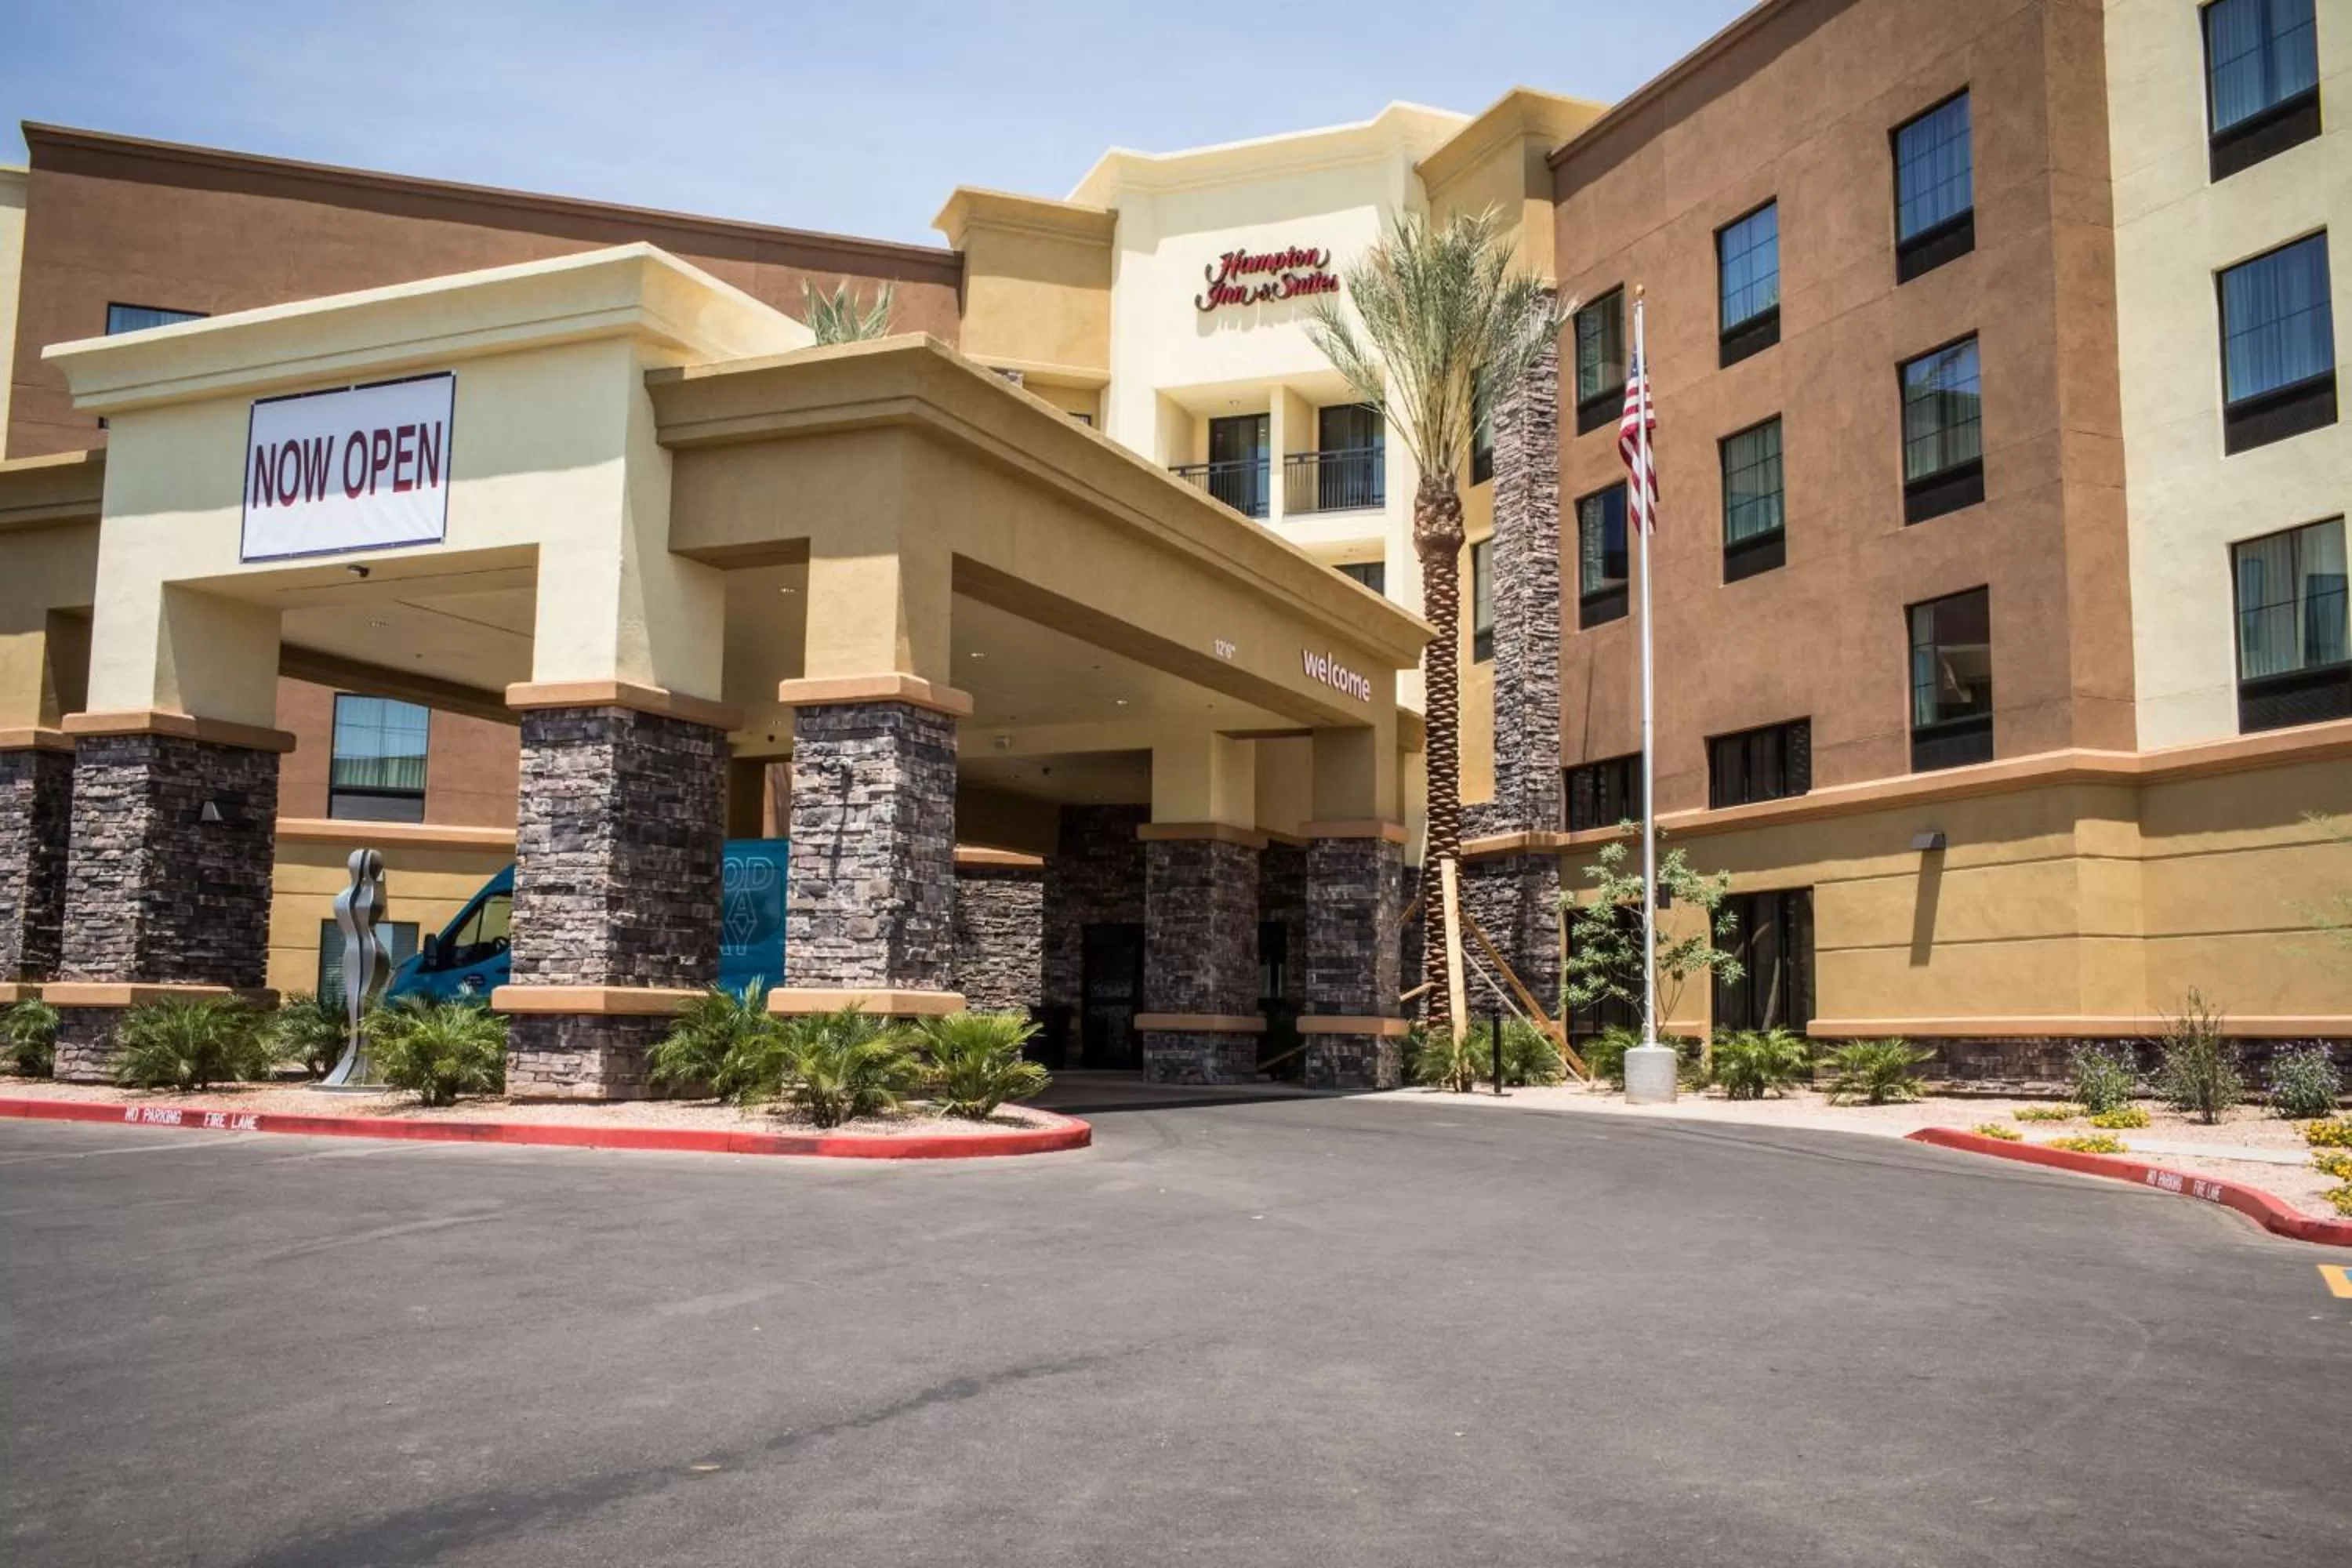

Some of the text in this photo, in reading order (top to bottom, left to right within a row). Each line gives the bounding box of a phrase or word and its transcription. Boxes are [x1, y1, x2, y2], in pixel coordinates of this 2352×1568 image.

[1205, 245, 1330, 283] Hampton
[1195, 283, 1258, 312] Inn
[1272, 271, 1340, 299] Suites
[252, 421, 441, 509] NOW OPEN
[1301, 649, 1371, 702] welcome
[125, 1106, 259, 1130] NO PARKING FIRE LANE
